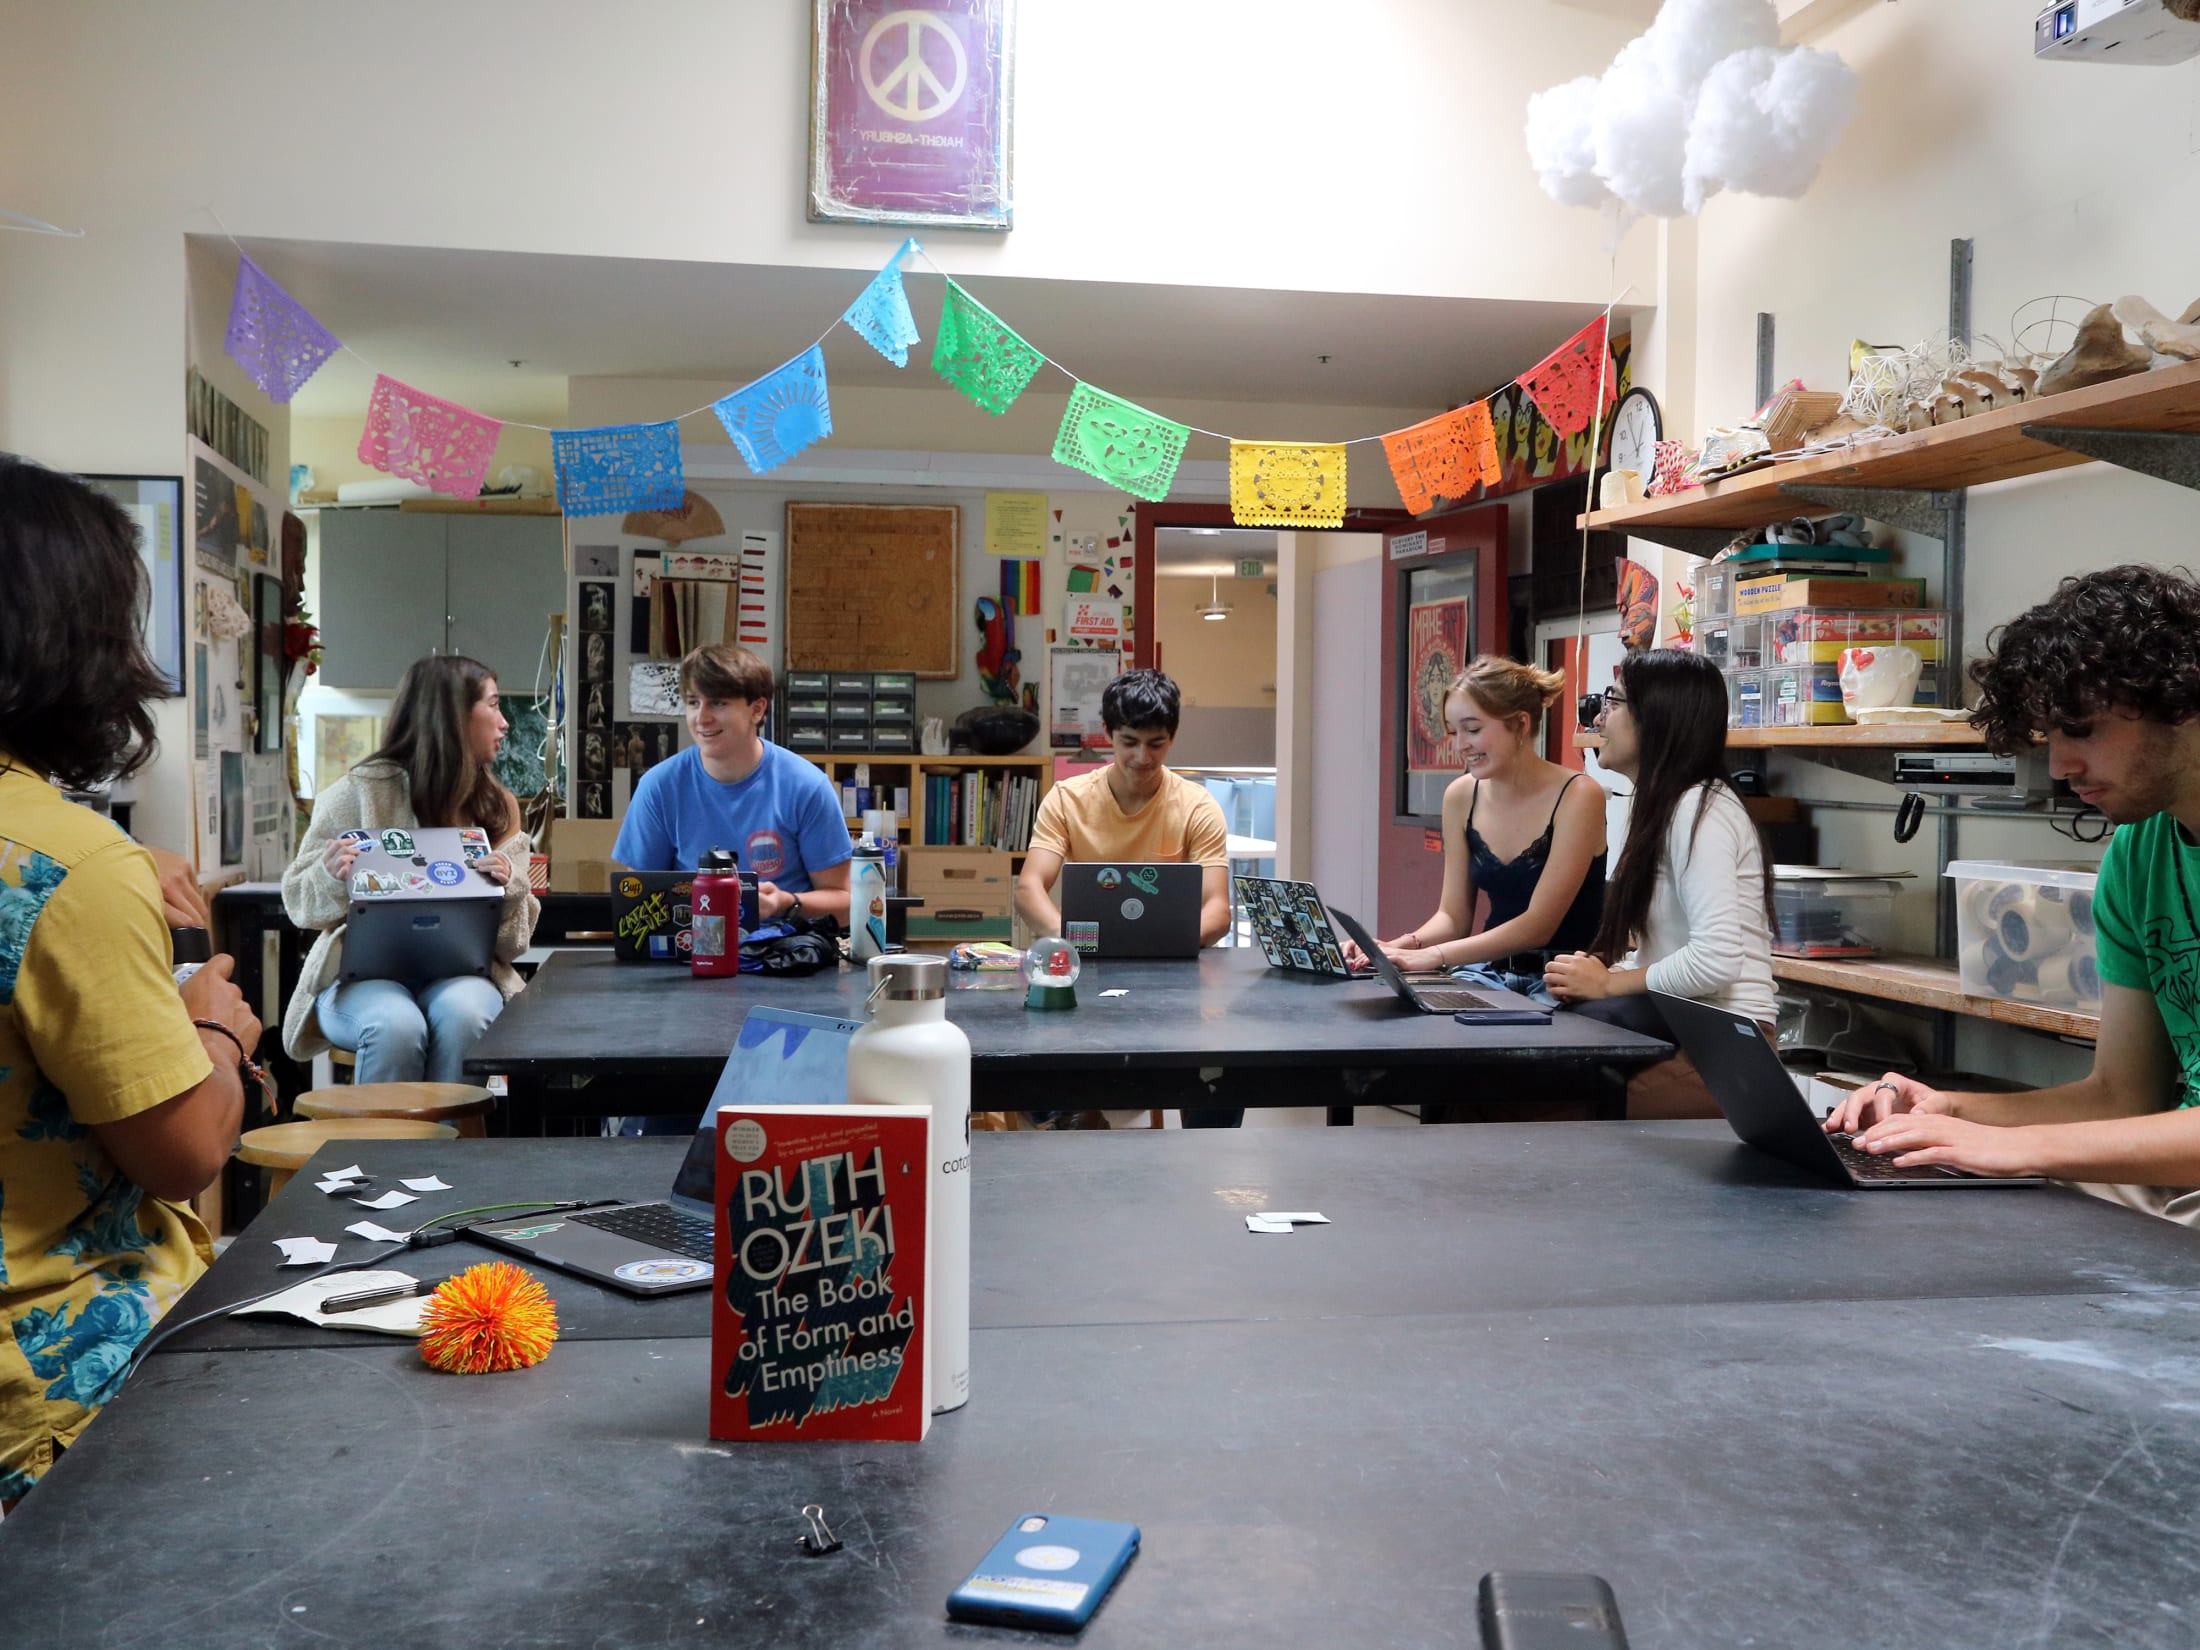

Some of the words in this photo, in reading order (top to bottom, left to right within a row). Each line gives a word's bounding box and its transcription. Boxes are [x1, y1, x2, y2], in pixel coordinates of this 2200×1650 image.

[1619, 429, 1627, 441] 10
[1618, 452, 1624, 464] 9
[1241, 560, 1261, 577] EXIT
[1739, 587, 1761, 597] WOODEN
[1075, 616, 1101, 626] FIRST
[1100, 616, 1114, 627] AID
[1414, 607, 1443, 658] MAKE
[1443, 604, 1464, 662] ART
[1413, 726, 1436, 766] NOT
[623, 880, 641, 895] Buff
[619, 891, 665, 937] CATCH
[742, 1146, 886, 1222] RUTH
[740, 1205, 895, 1281] OZEKI
[755, 1286, 809, 1320] The
[818, 1265, 894, 1308] Book
[738, 1326, 767, 1361] of
[776, 1322, 851, 1354] Form
[858, 1296, 915, 1337] and
[761, 1346, 903, 1393] Emptiness
[880, 1405, 903, 1417] Novel
